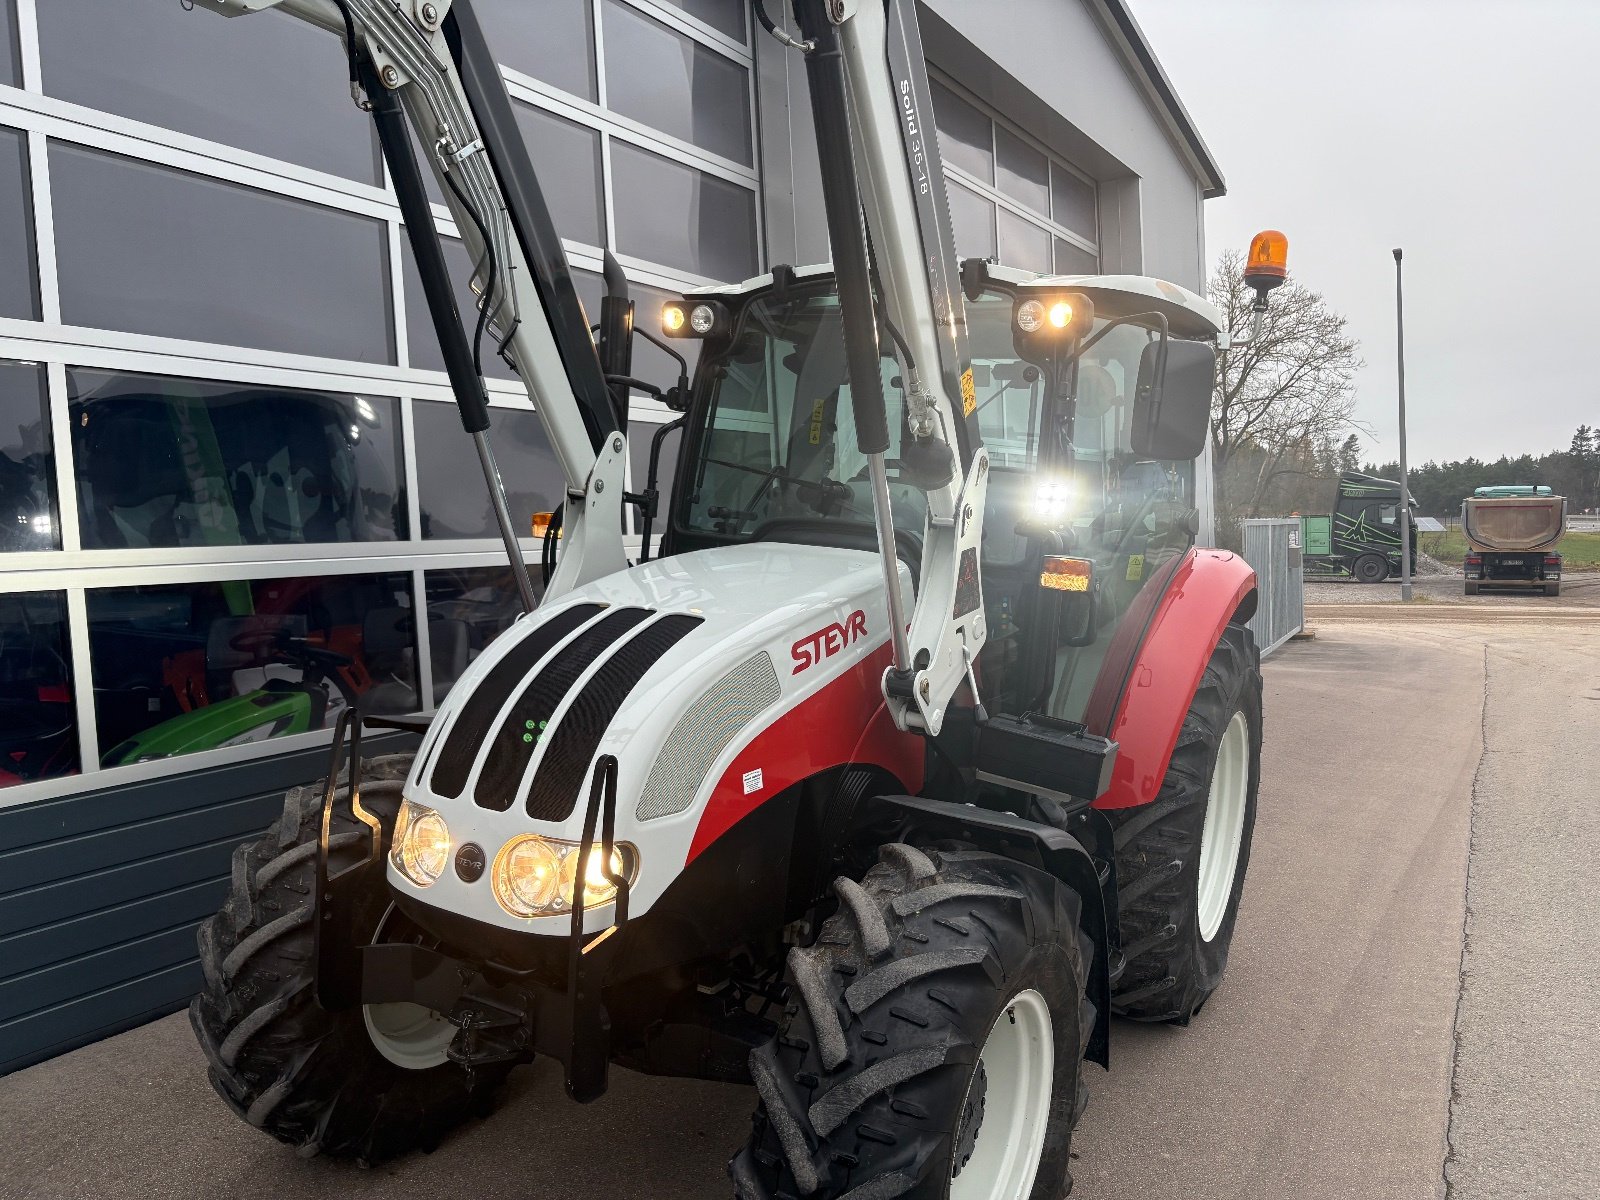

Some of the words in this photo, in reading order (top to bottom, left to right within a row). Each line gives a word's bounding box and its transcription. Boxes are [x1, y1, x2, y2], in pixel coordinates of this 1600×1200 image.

[900, 79, 918, 136] Solid
[912, 140, 928, 195] 35-18
[790, 609, 868, 676] STEYR
[456, 856, 483, 870] STEYR
